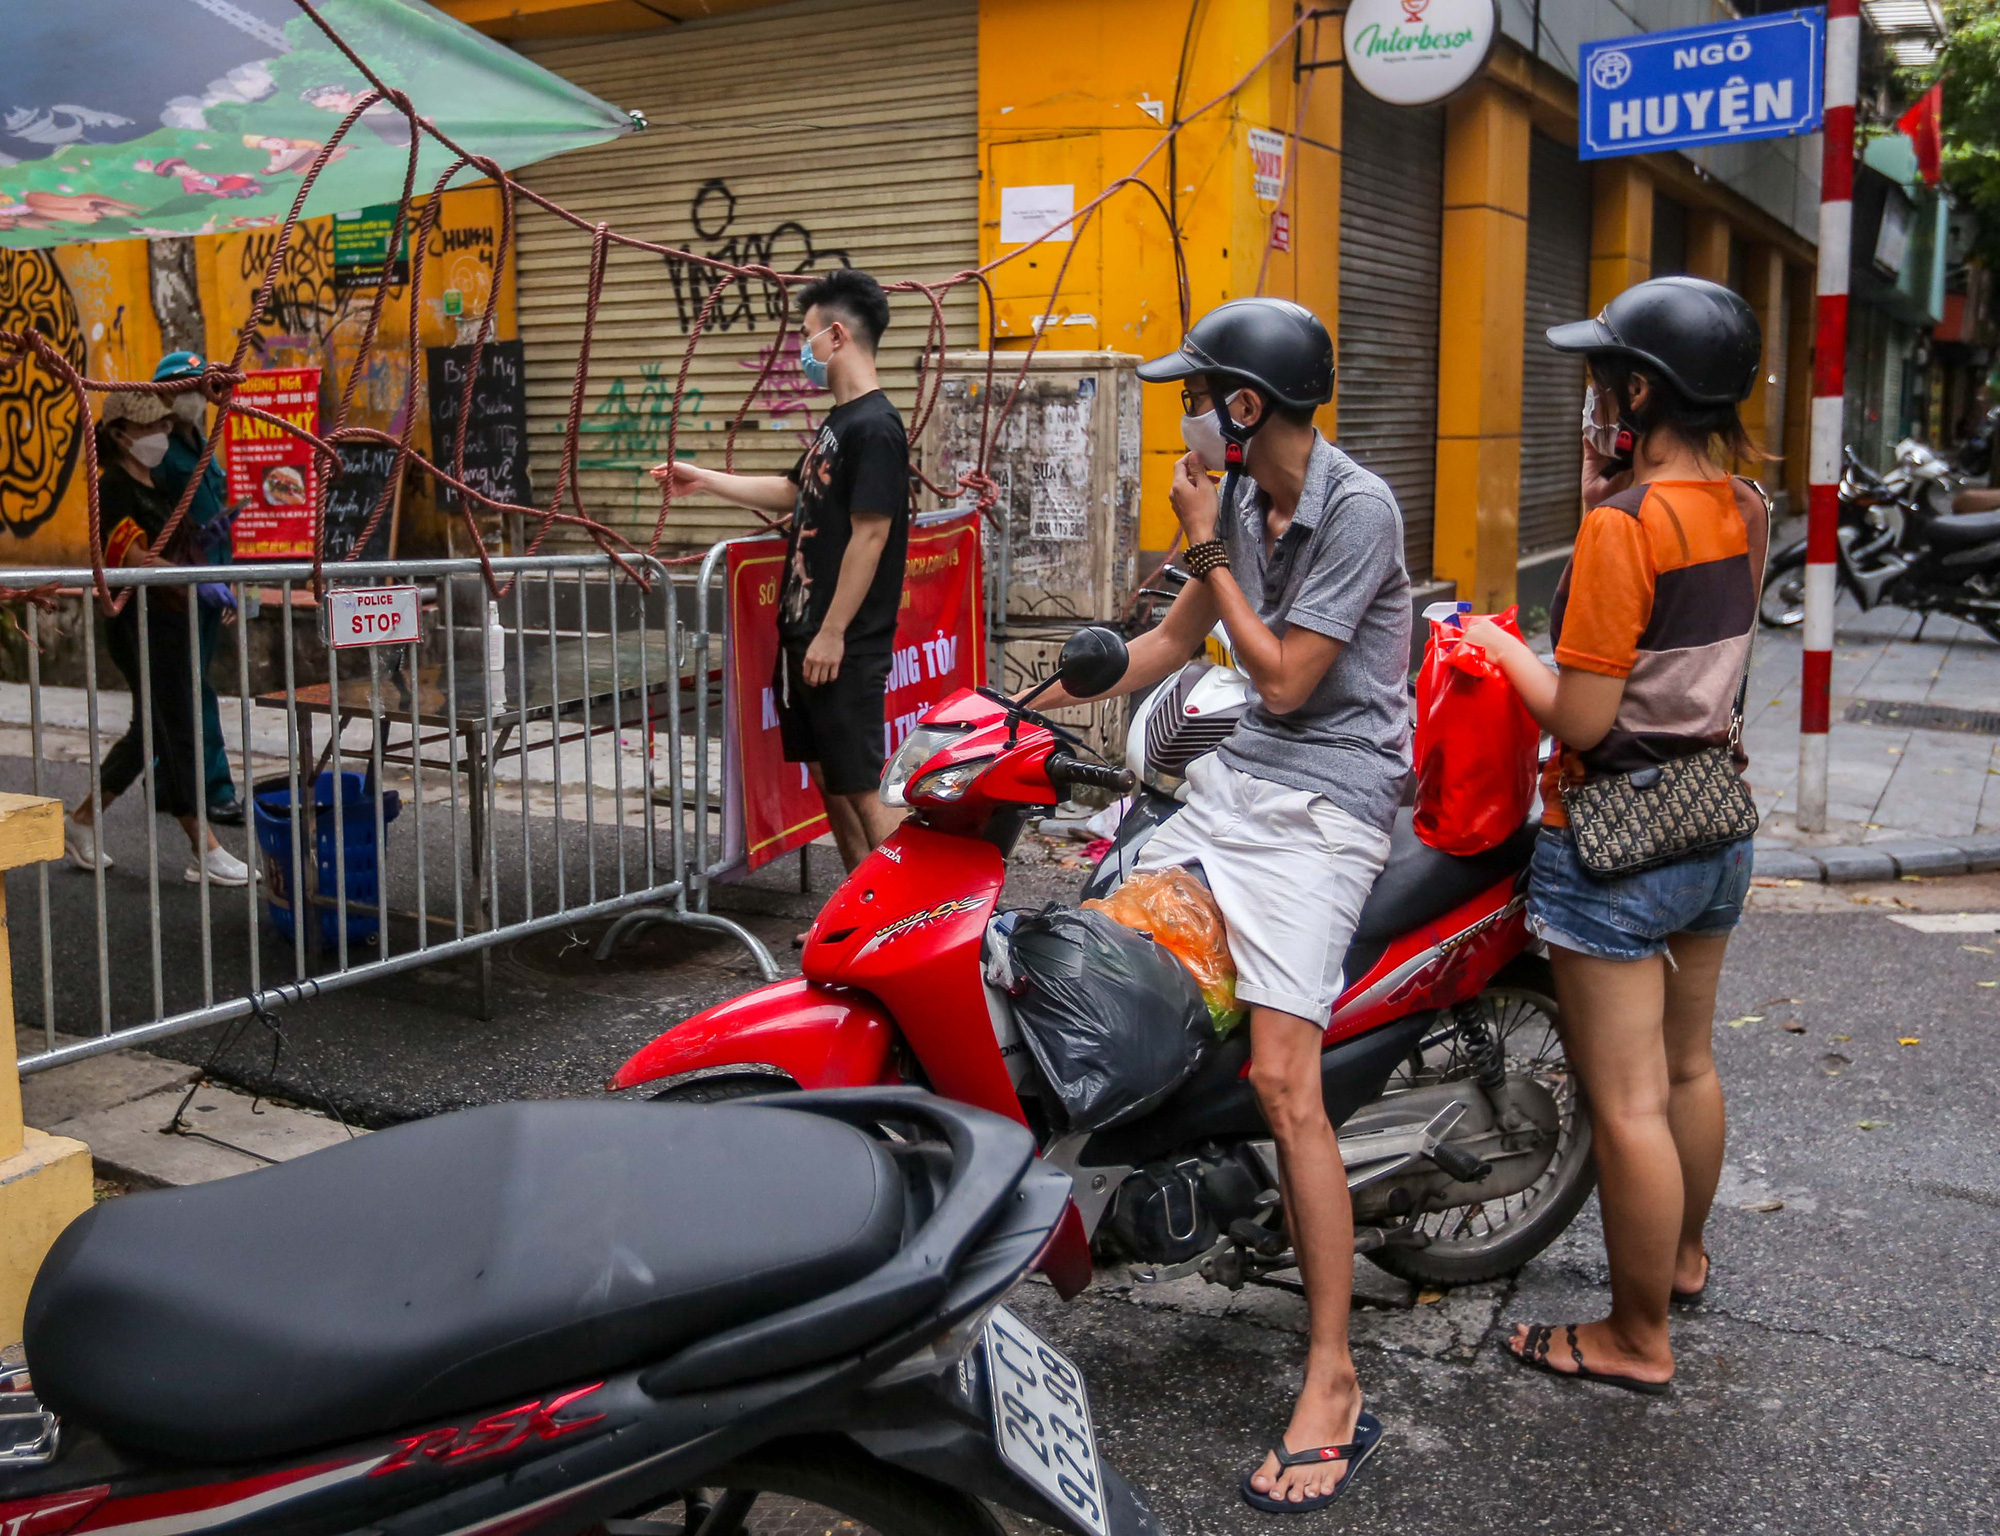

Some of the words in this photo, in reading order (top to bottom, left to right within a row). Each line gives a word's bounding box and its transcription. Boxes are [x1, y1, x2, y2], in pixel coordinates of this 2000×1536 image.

[1674, 34, 1751, 70] NGÕ
[1609, 76, 1793, 140] HUYỆN
[351, 612, 402, 634] STOP
[357, 594, 393, 607] POLICE
[991, 1319, 1050, 1468] 29-C1
[1036, 1345, 1101, 1522] 923.98
